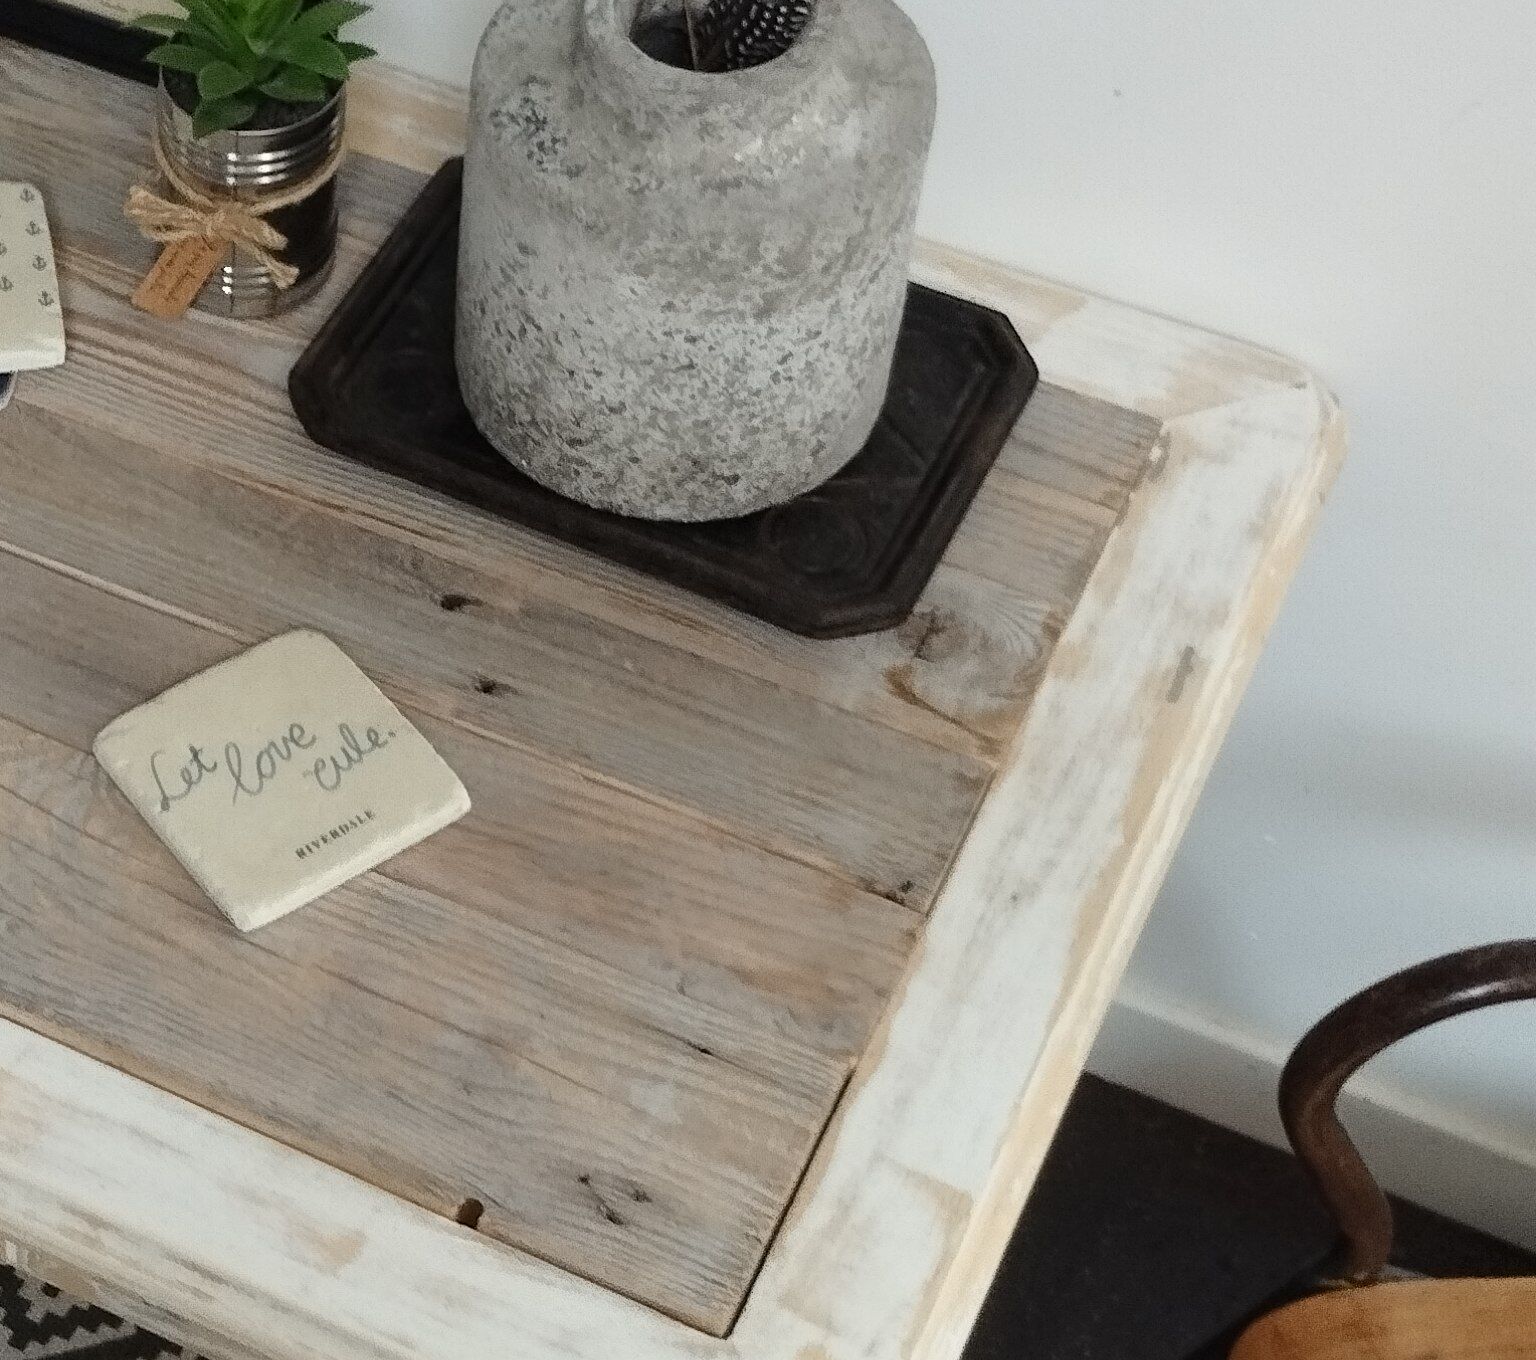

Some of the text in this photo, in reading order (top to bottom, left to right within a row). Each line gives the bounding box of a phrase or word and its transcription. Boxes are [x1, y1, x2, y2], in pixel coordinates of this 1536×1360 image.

[150, 743, 218, 813] Let
[224, 722, 317, 806] love
[294, 809, 376, 860] RIVERDALE
